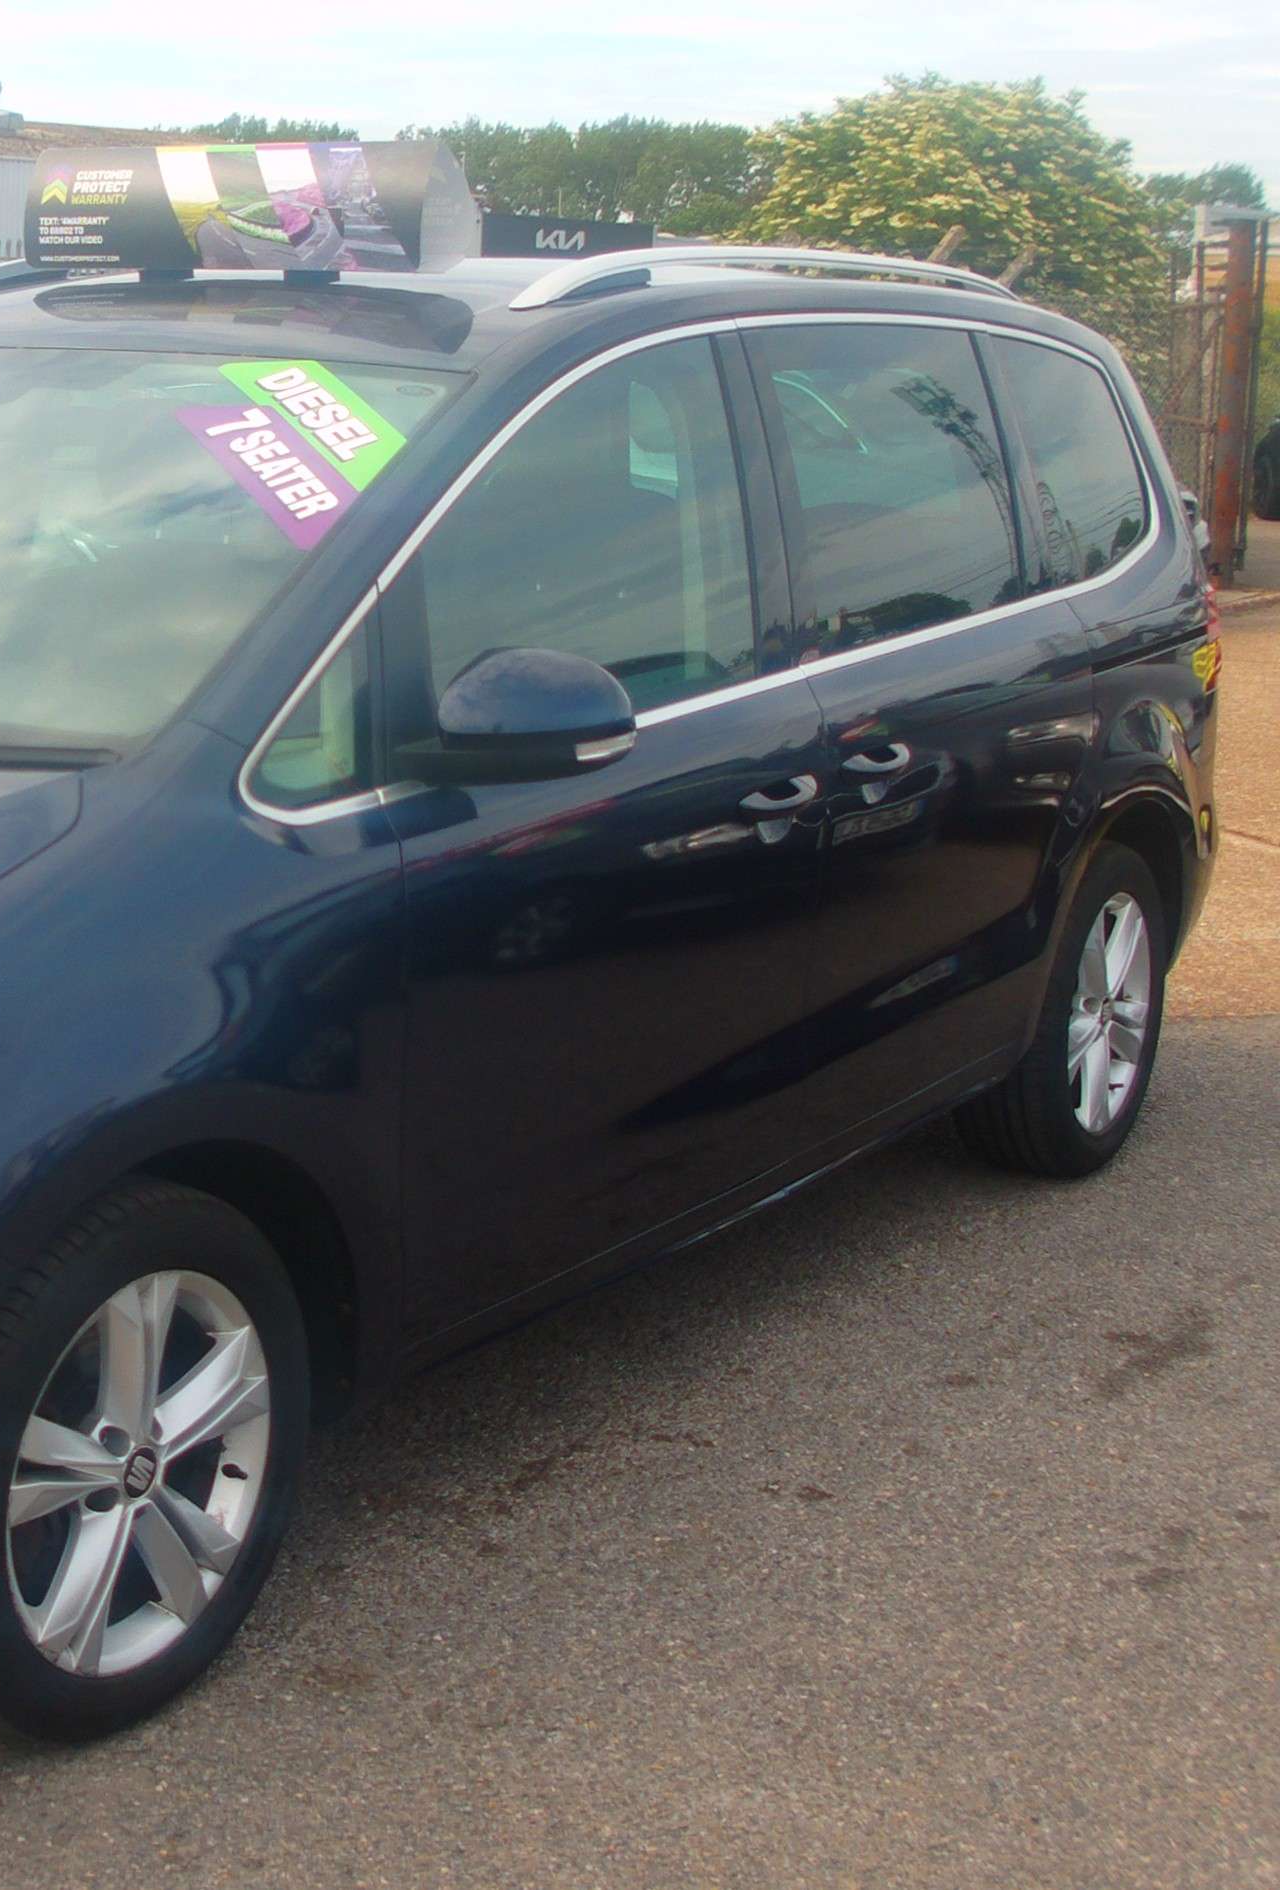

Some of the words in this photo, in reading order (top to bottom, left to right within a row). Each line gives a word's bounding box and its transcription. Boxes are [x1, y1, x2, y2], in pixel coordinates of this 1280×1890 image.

[76, 170, 134, 181] CUSTOMER
[72, 181, 131, 193] PROTECT
[71, 194, 128, 205] WARRANTY
[39, 235, 64, 244] WATCH
[64, 235, 80, 244] OUR
[80, 235, 103, 244] VIDEO
[535, 228, 585, 251] KIA
[205, 408, 272, 437] 7
[255, 367, 379, 462] DIESEL
[229, 430, 339, 520] SEATER
